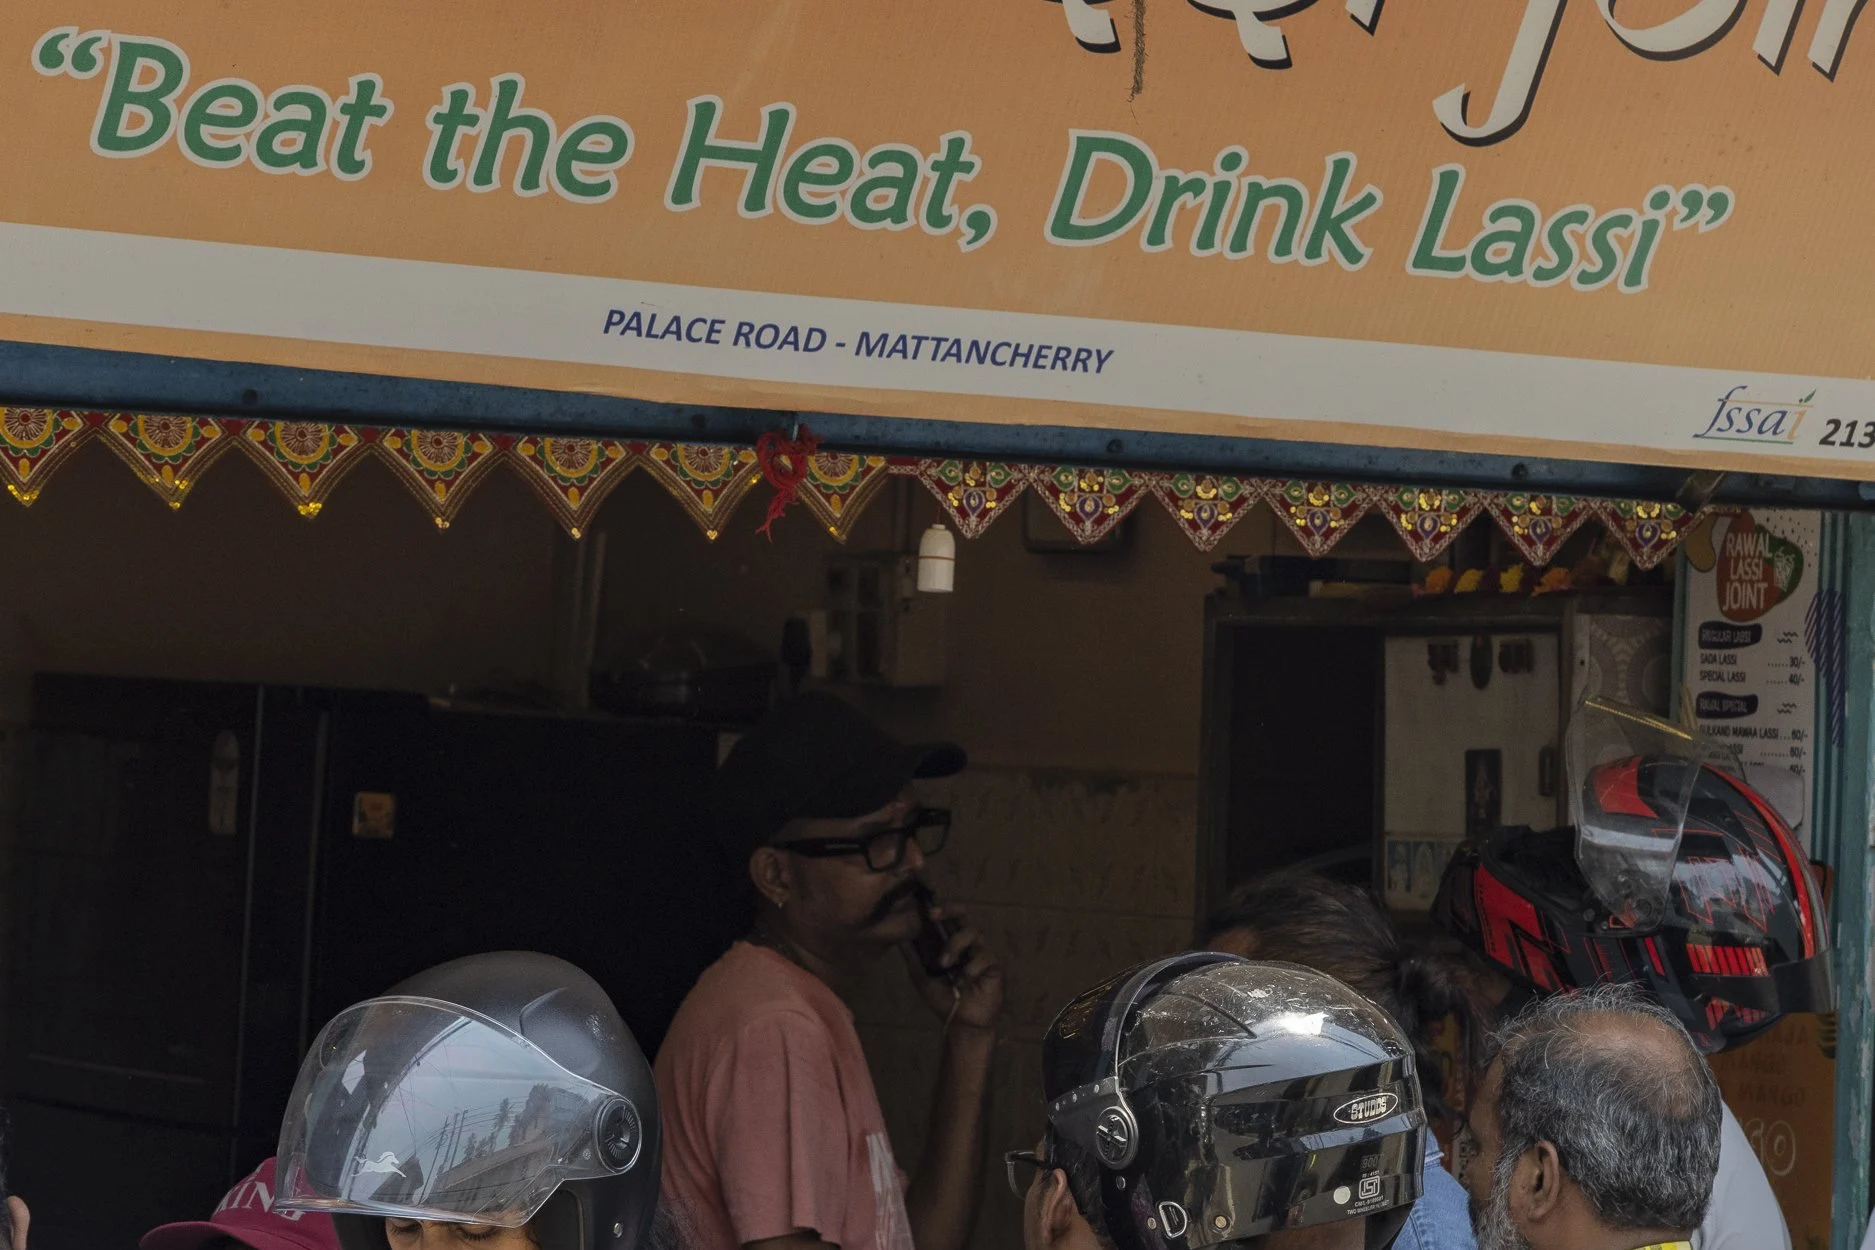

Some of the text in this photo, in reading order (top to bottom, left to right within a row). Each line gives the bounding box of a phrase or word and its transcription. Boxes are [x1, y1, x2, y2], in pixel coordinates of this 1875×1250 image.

[423, 72, 634, 203] the
[664, 95, 998, 253] Heat,
[1044, 128, 1383, 271] Drink
[603, 309, 725, 344] PALACE
[732, 321, 828, 352] ROAD
[854, 331, 1114, 374] MATTANCHERRY
[1692, 385, 1816, 443] fssai
[1725, 532, 1773, 558] RAWAL
[1730, 557, 1763, 581] LASSI
[1722, 581, 1768, 611] JOINT
[1700, 653, 1717, 665] SADA
[1719, 654, 1737, 666] LASSI
[1699, 670, 1725, 682] SPECIAL
[1727, 671, 1746, 683] LASSI
[1759, 726, 1779, 739] LASSI
[1350, 1096, 1387, 1121] STUDDS
